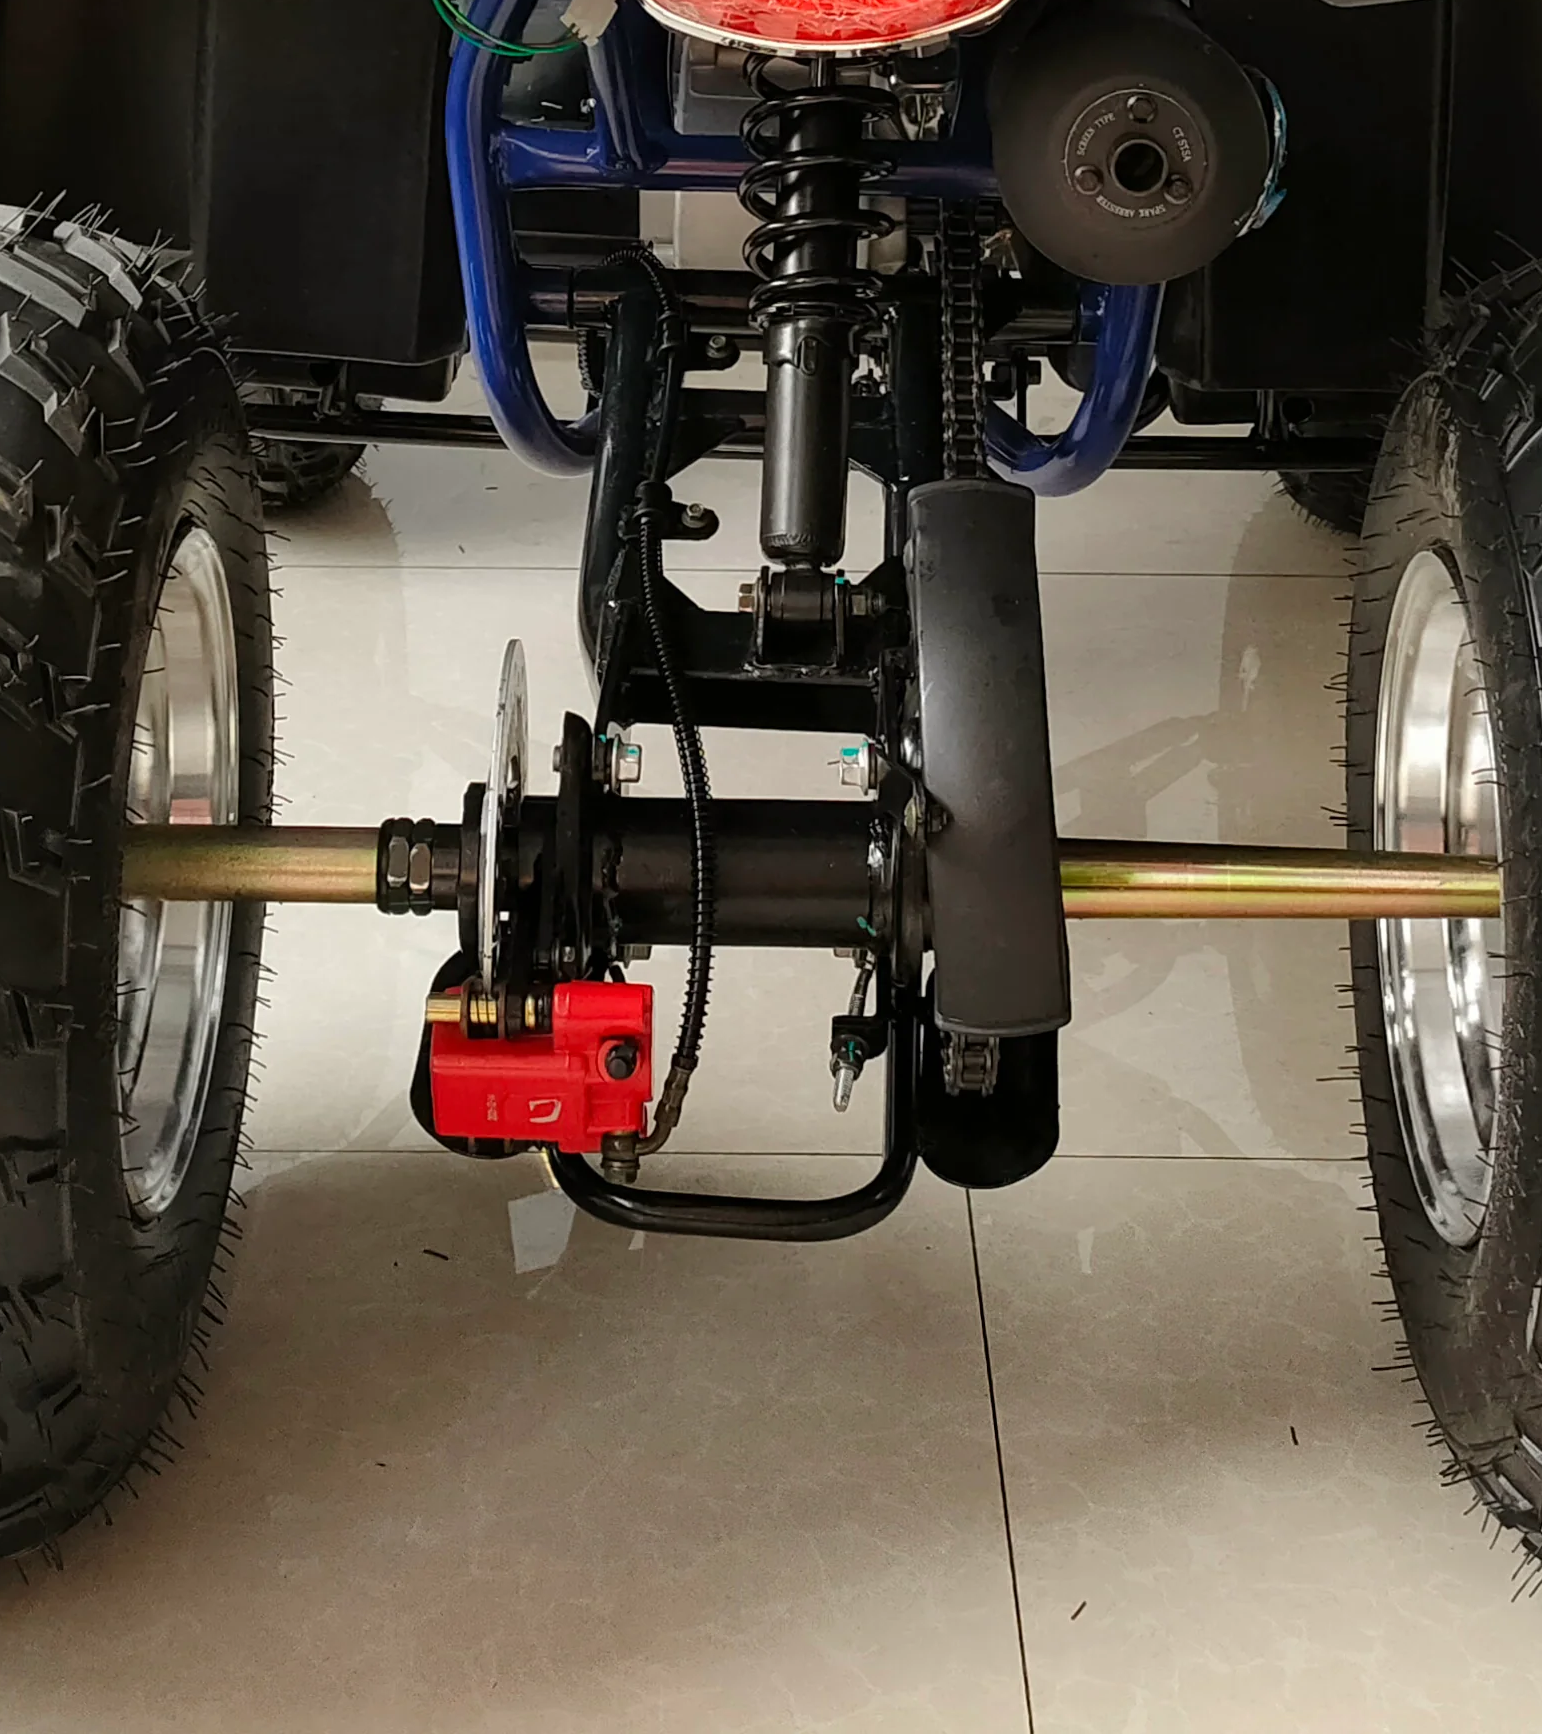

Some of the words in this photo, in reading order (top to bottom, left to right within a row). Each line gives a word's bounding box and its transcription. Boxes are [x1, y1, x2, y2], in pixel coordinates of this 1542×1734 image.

[1076, 127, 1095, 156] SCREEN
[1094, 112, 1116, 128] TYPE
[1095, 194, 1135, 218] ARRESTER
[1138, 204, 1167, 218] SPARK
